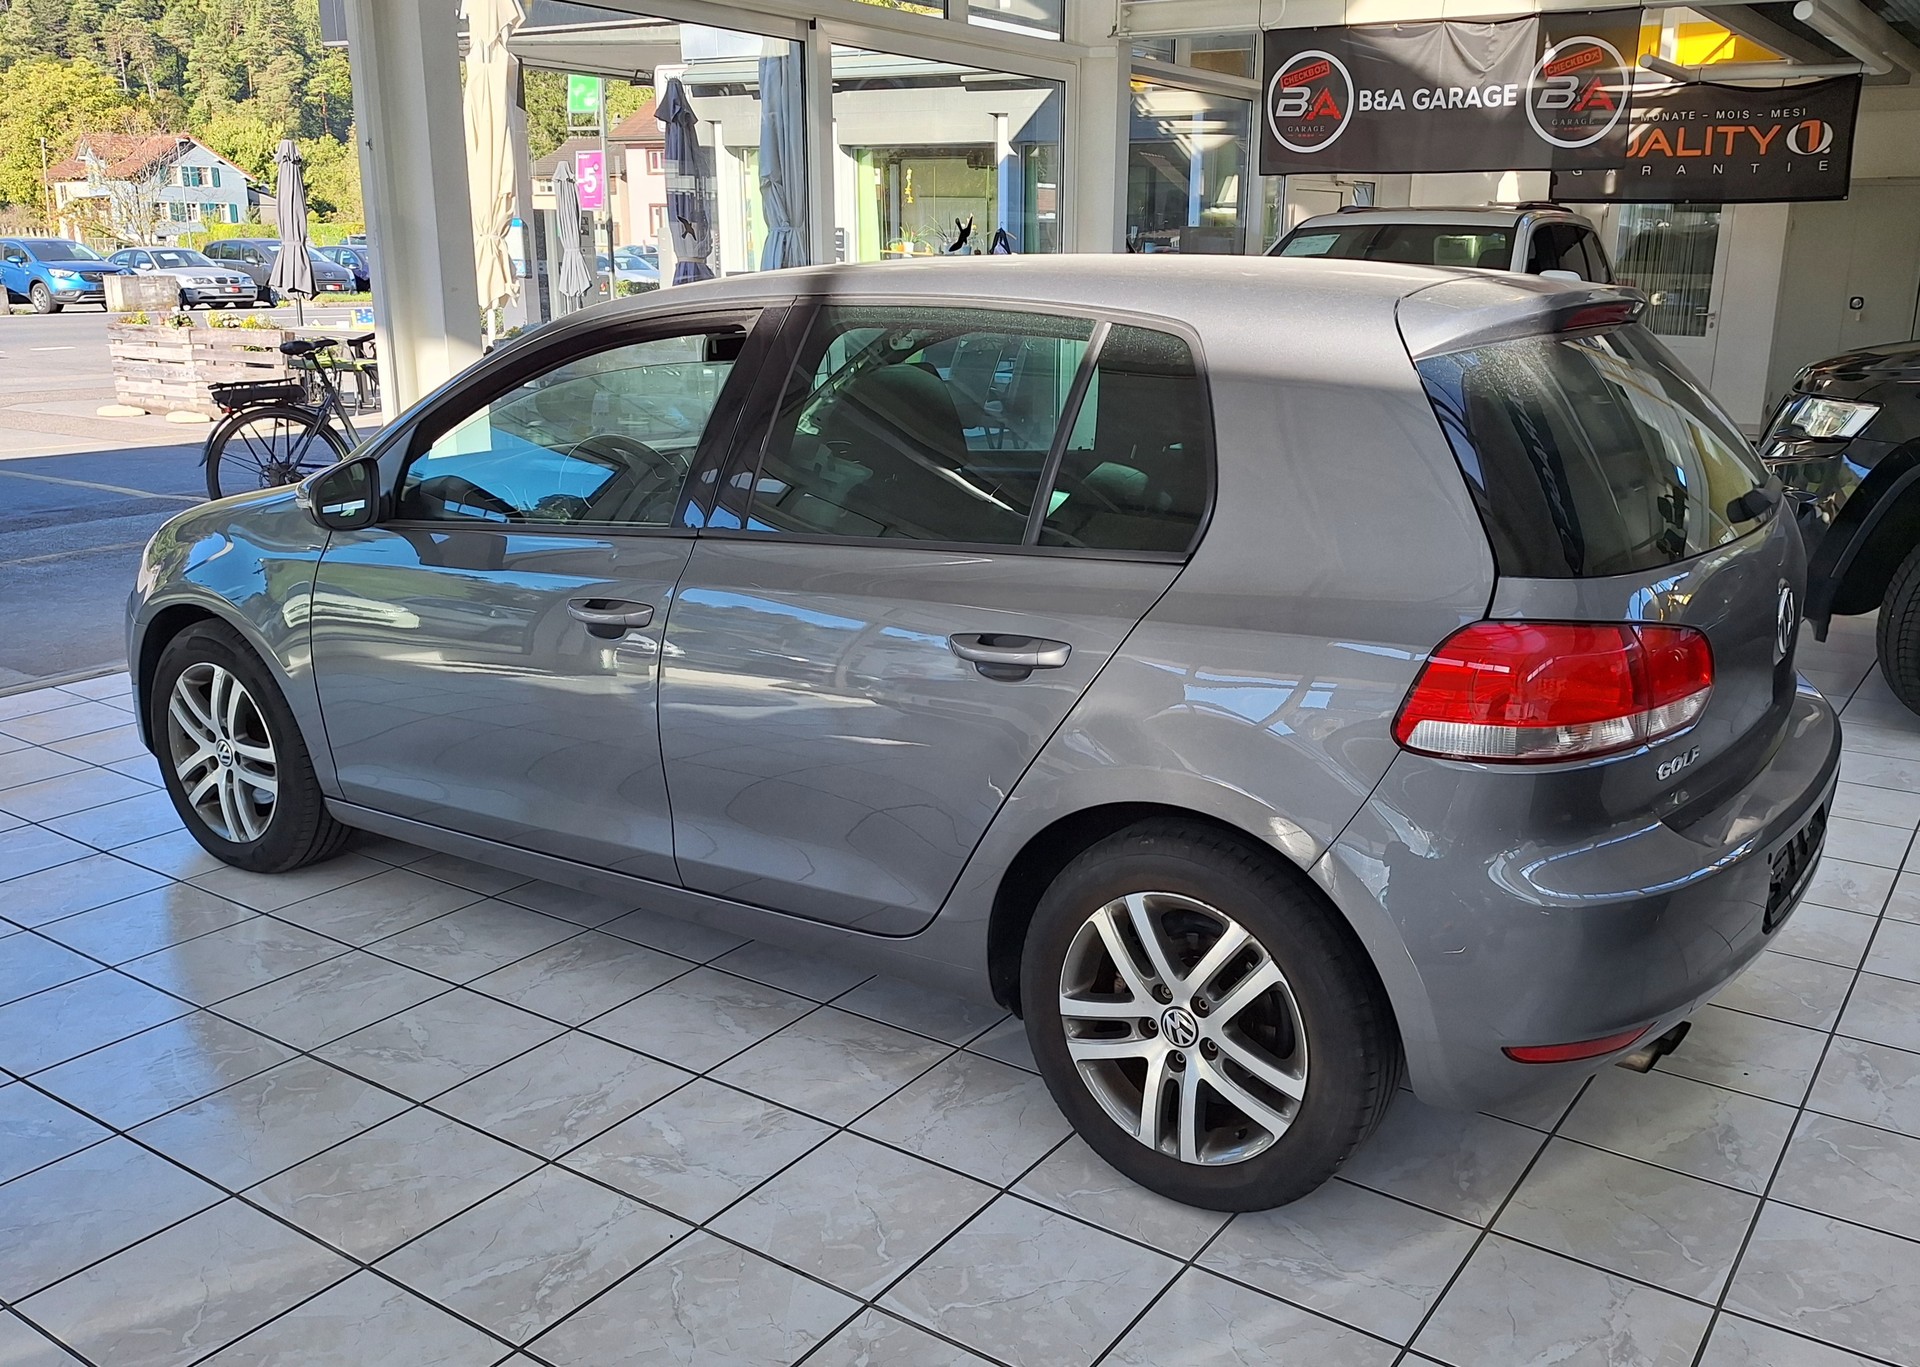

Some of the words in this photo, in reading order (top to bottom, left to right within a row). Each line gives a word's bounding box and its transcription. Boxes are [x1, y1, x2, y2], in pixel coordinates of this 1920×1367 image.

[1547, 51, 1600, 75] CHECKBOX
[1283, 64, 1328, 86] CHECKBOX
[1358, 89, 1406, 111] B&A
[1412, 83, 1519, 111] GARAGE
[1551, 118, 1595, 126] GARAGE
[1641, 110, 1696, 122] MONATE
[1715, 110, 1750, 119] MOIS
[1770, 107, 1806, 118] MESI
[1287, 125, 1325, 133] GARAGE
[1656, 745, 1700, 781] GOLF
